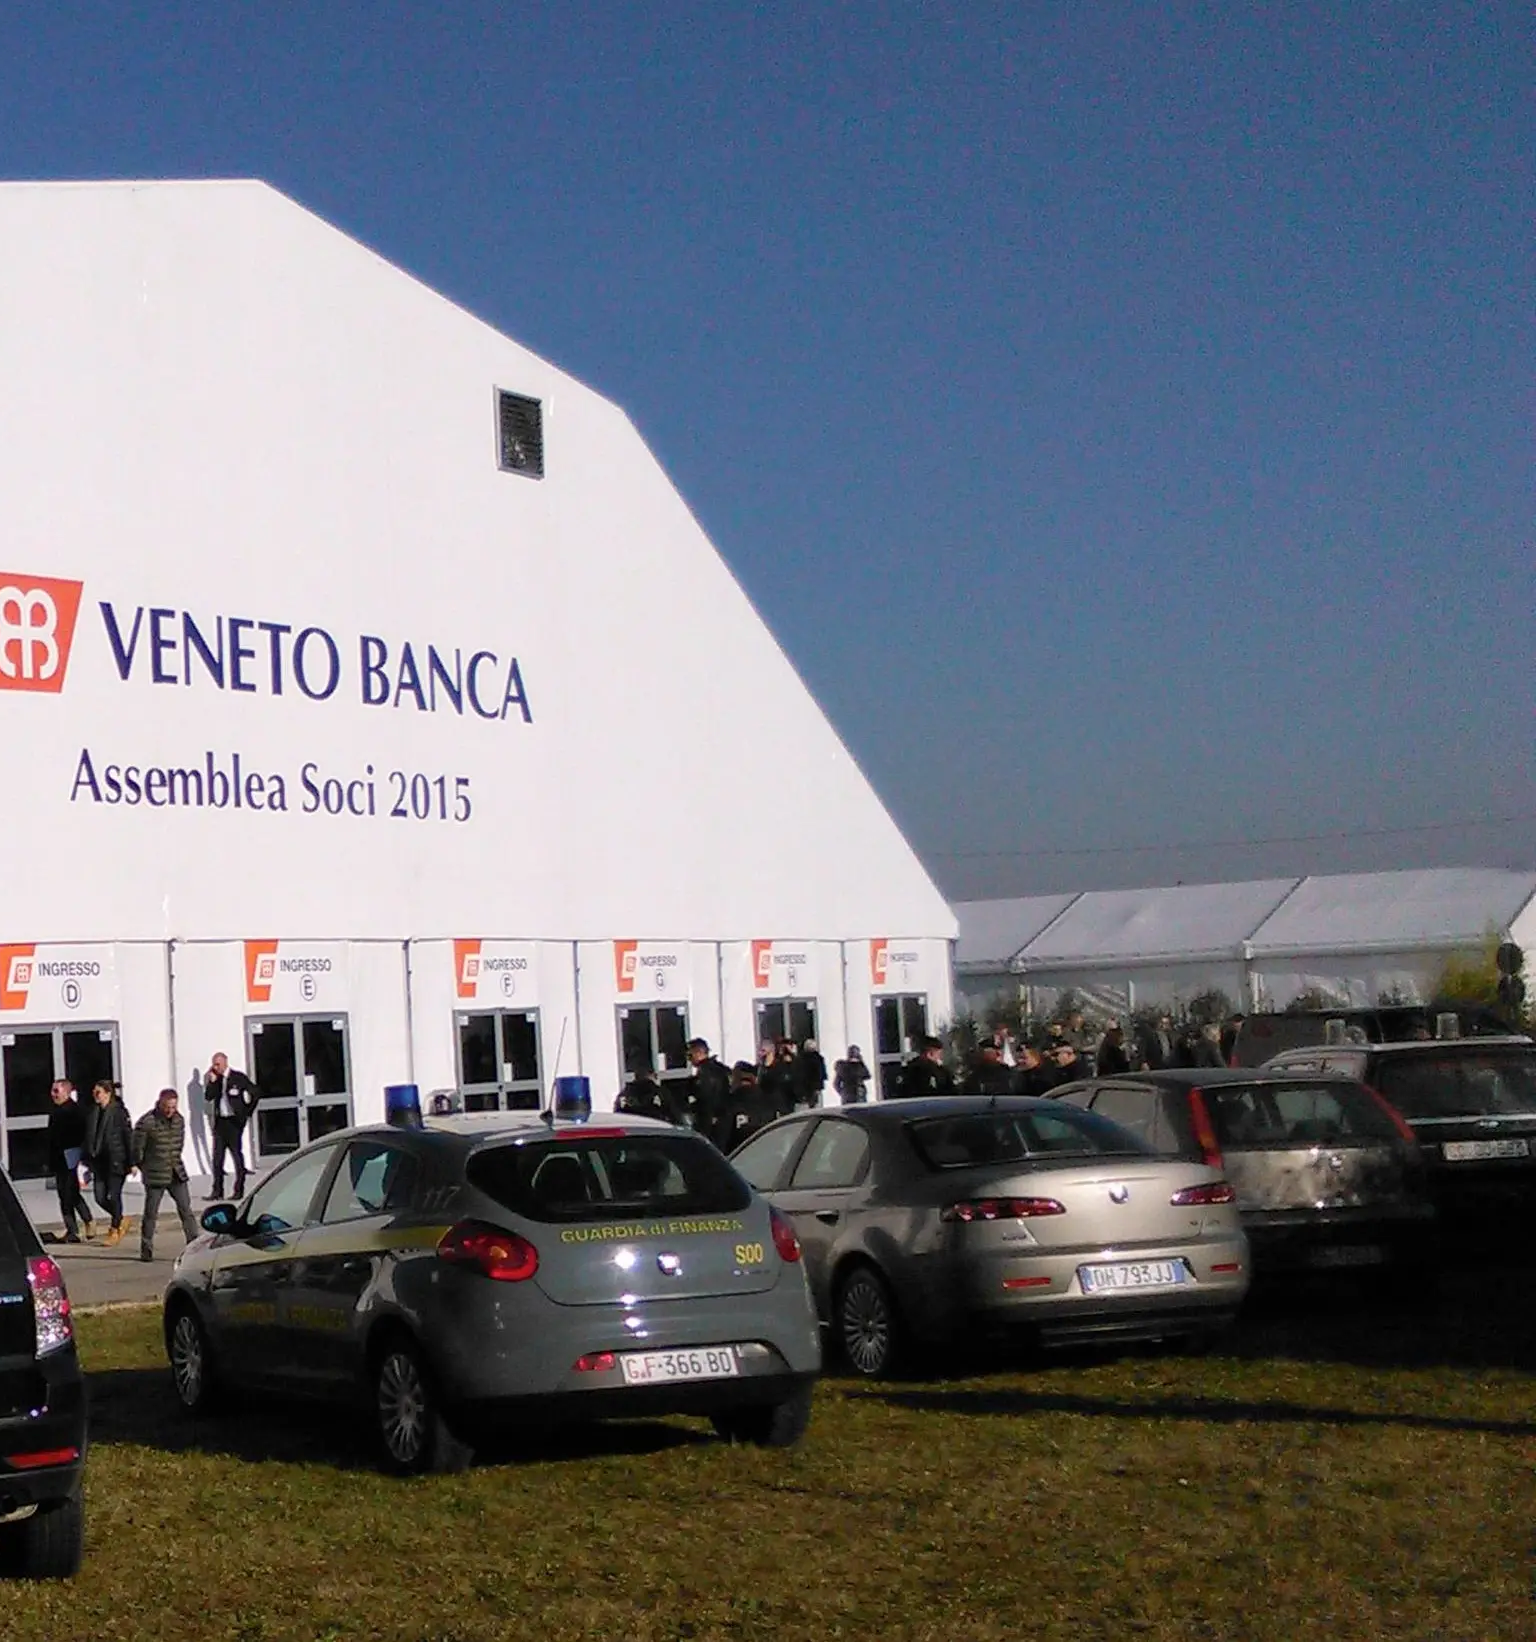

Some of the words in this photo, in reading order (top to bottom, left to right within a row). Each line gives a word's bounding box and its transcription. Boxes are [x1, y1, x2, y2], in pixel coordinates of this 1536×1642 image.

[98, 600, 341, 701] VENETO
[360, 634, 533, 724] BANCA
[70, 748, 287, 812] Assemblea
[301, 763, 375, 816] Soci
[389, 771, 472, 823] 2015
[279, 958, 332, 973] INGRESSO
[483, 957, 527, 972] INGRESSO
[639, 955, 677, 968] INGRESSO
[773, 953, 807, 966] INGRESSO
[38, 961, 101, 977] INGRESSO
[66, 984, 78, 1003] D
[303, 979, 313, 997] E
[560, 1223, 646, 1243] GUARDIA
[650, 1221, 666, 1236] di
[670, 1218, 743, 1234] FINANZA
[1120, 1265, 1153, 1285] 793
